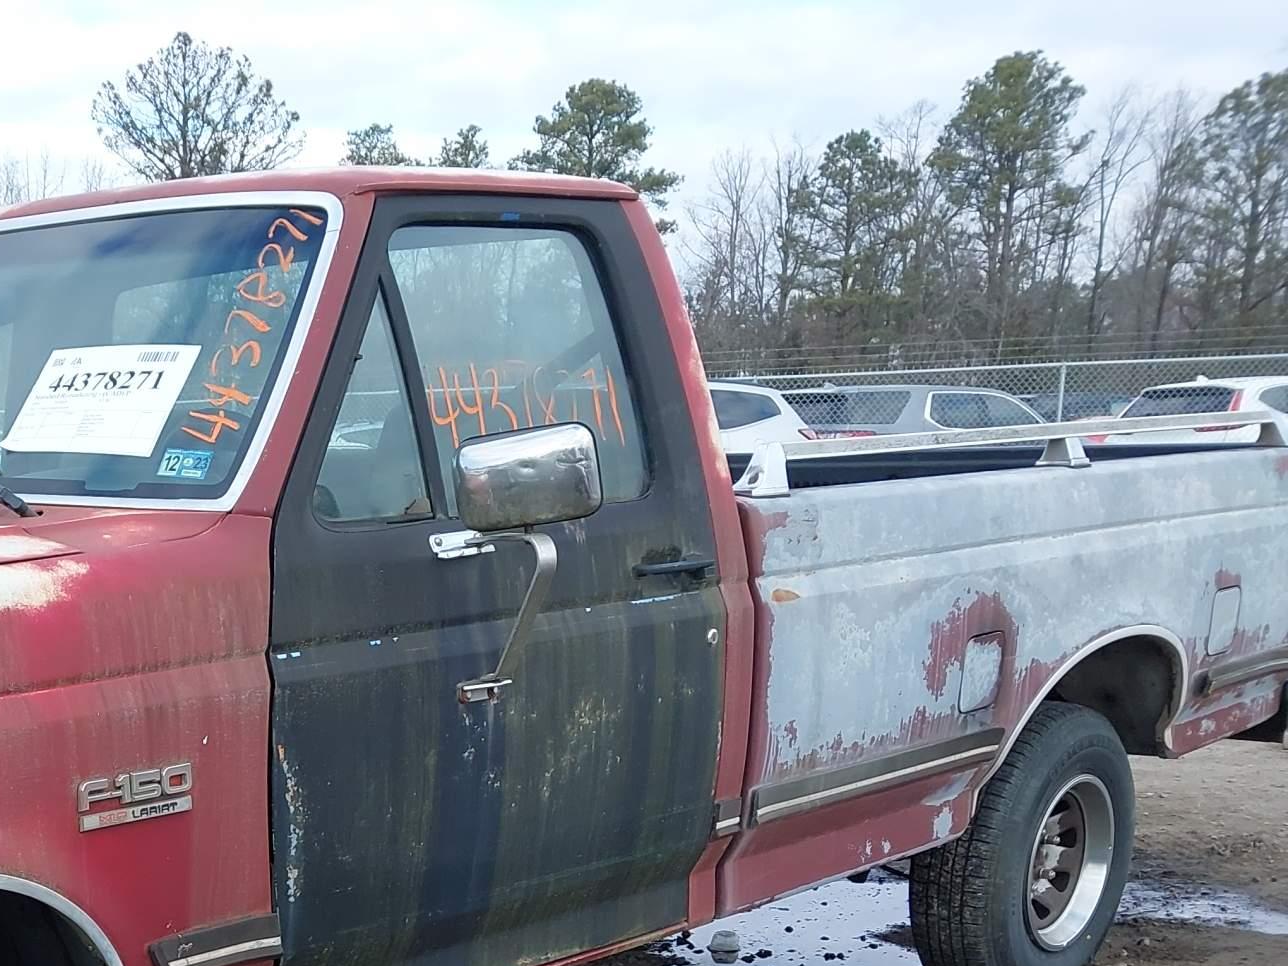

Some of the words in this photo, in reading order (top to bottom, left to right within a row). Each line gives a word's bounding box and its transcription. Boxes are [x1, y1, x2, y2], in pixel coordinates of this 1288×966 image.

[49, 370, 165, 392] 44378271
[163, 455, 181, 472] 12
[192, 456, 209, 470] 23
[78, 762, 192, 812] F-150
[131, 800, 179, 819] LARIAT
